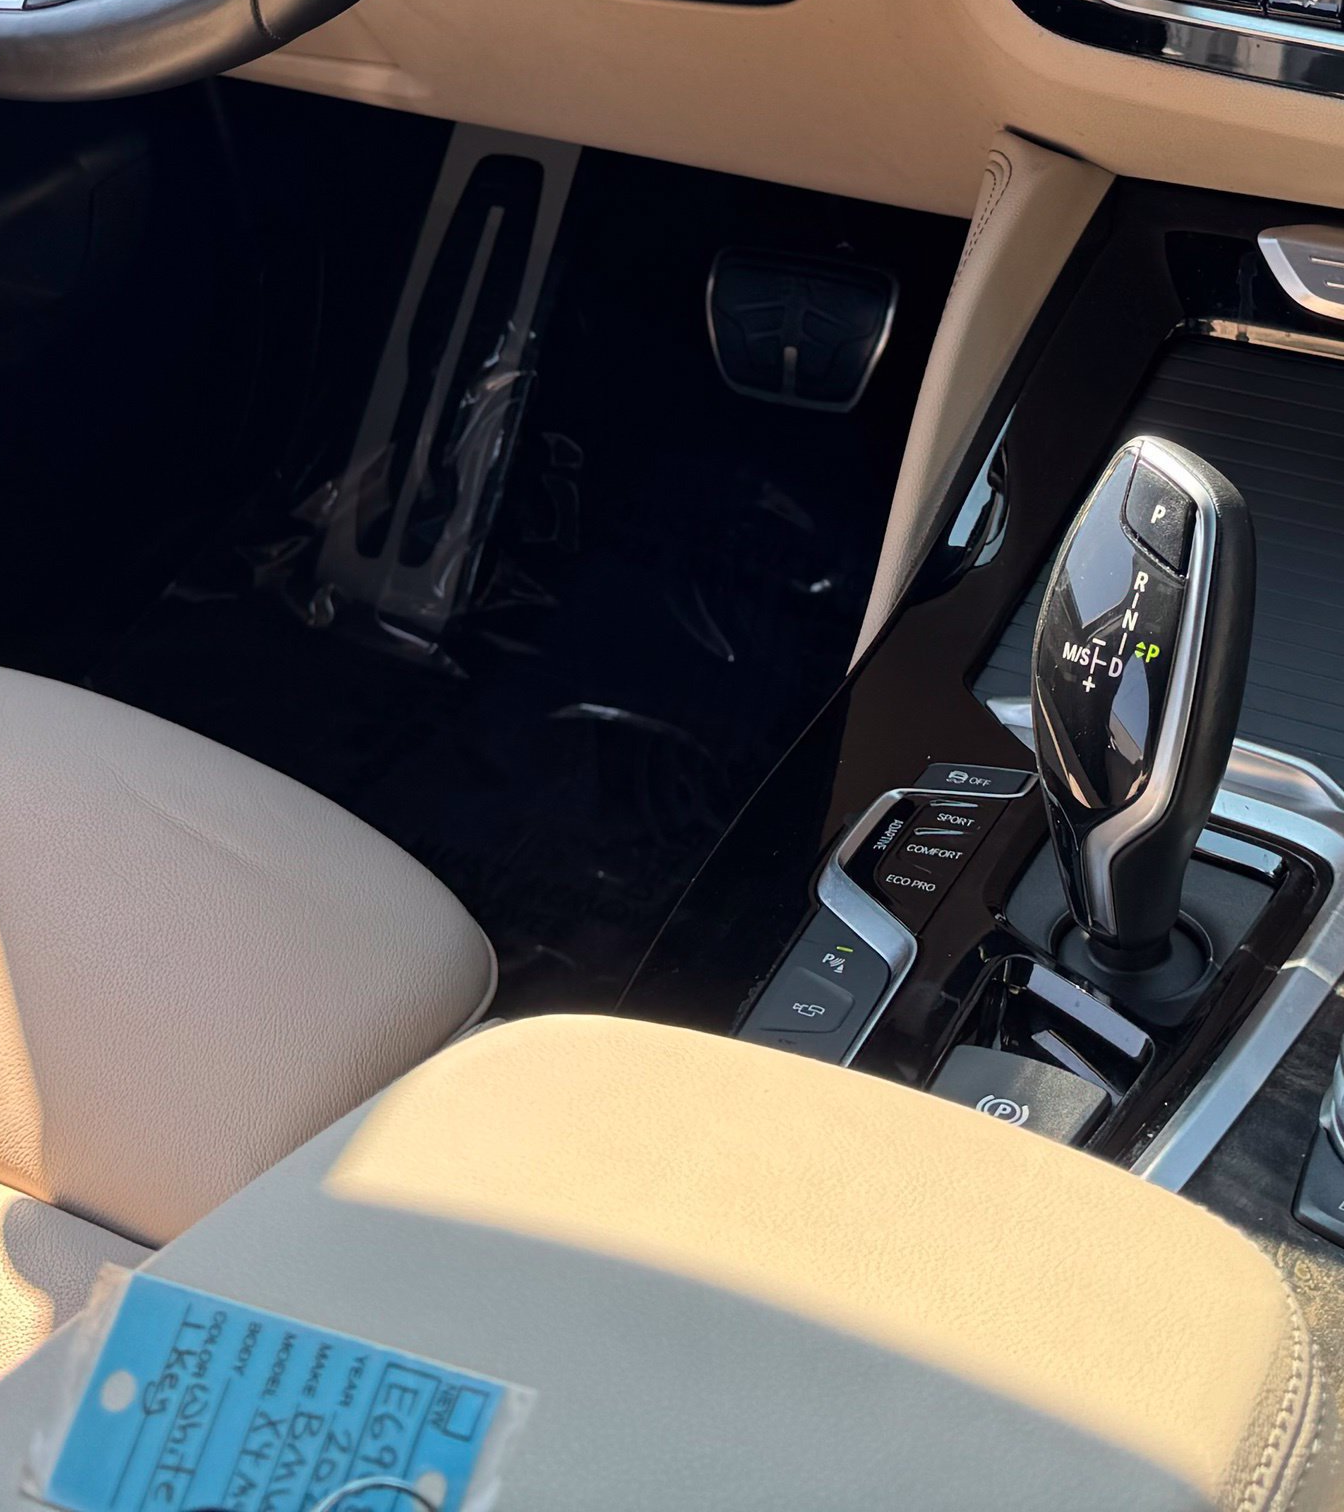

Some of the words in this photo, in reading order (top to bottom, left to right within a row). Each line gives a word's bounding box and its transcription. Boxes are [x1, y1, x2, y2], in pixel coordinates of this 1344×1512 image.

[1150, 504, 1167, 525] P
[1133, 570, 1149, 593] R
[1121, 608, 1139, 632] N
[1062, 641, 1090, 667] M/S
[1145, 643, 1161, 664] P
[1108, 656, 1124, 679] D
[968, 776, 992, 787] OFF
[936, 812, 976, 828] SPORT
[873, 818, 905, 851] ADAPTIVE
[906, 843, 963, 861] COMFORT
[885, 874, 911, 886] ECO
[911, 879, 936, 892] PRO
[191, 1310, 228, 1379] COLOR
[233, 1320, 263, 1378] BODY
[261, 1331, 297, 1399] MODEL
[302, 1342, 334, 1399] MAKE
[338, 1354, 369, 1409] YEAR
